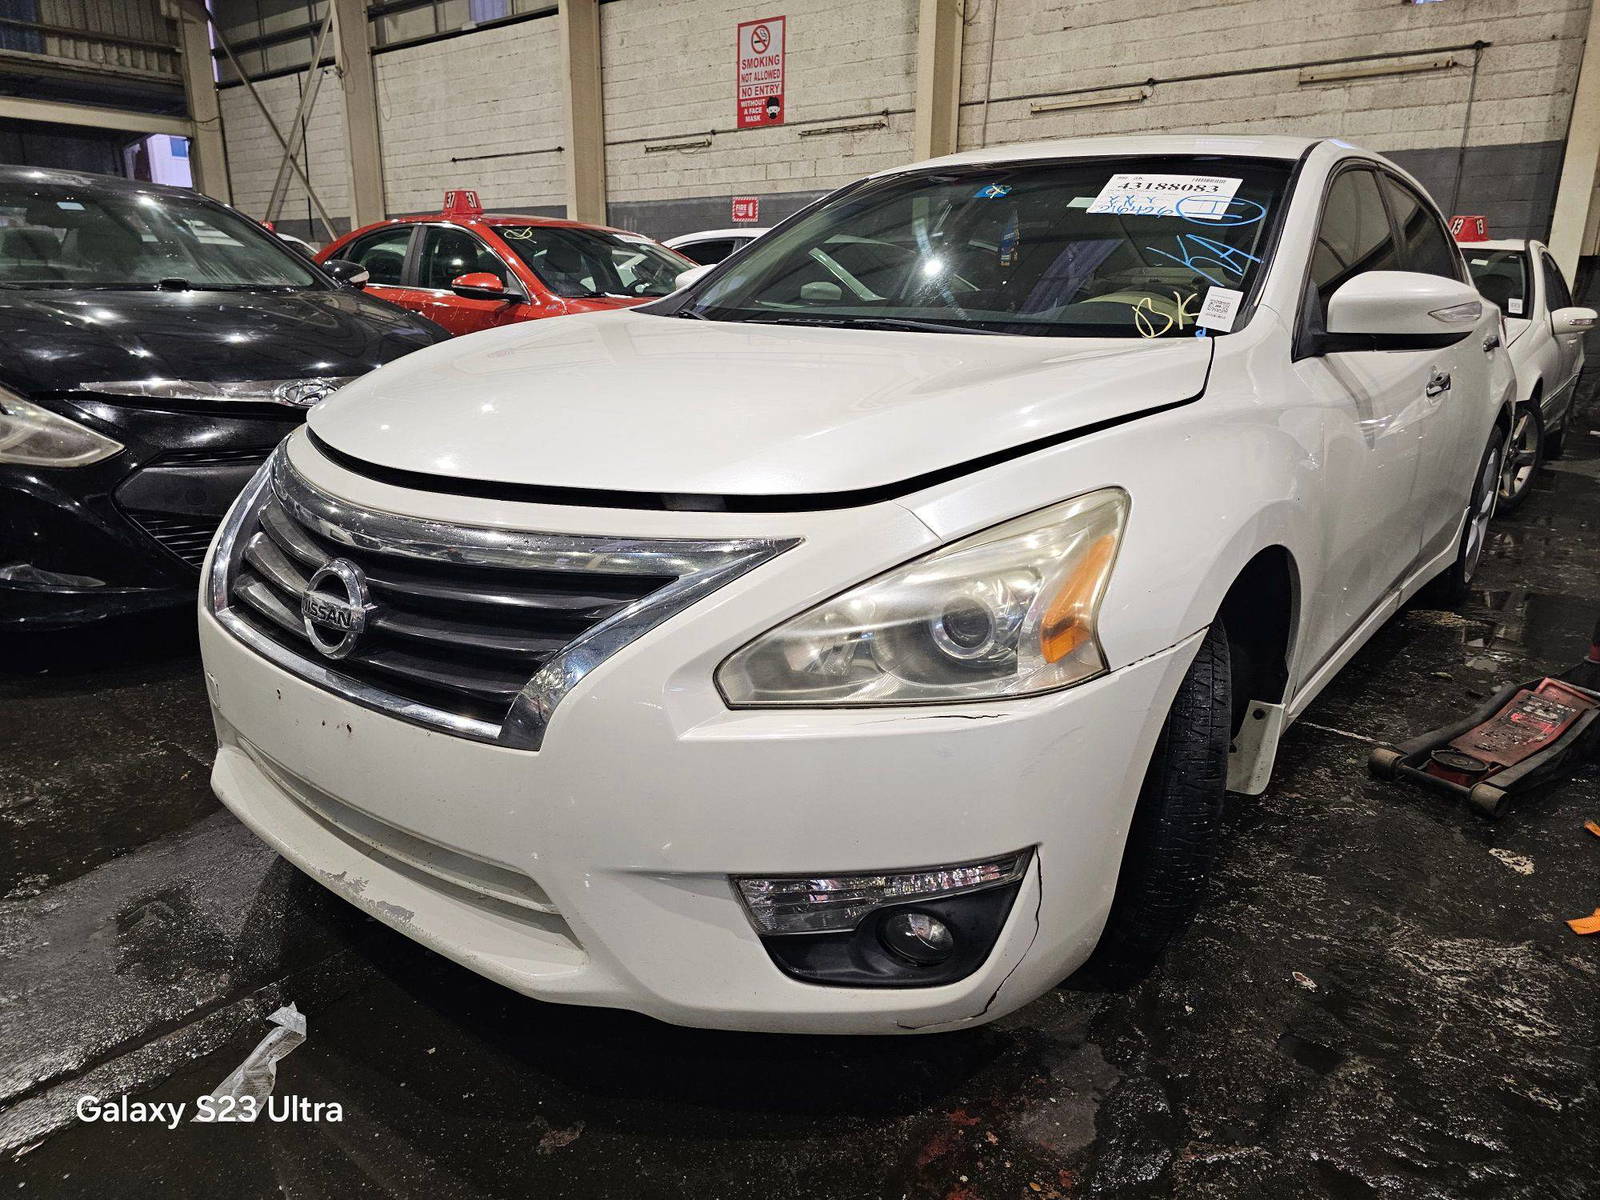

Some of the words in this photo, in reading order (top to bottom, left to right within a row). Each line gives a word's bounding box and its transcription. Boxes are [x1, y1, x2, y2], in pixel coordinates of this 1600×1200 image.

[741, 55, 780, 70] SMOKING
[741, 72, 752, 83] NOT
[754, 69, 780, 81] ALLOWED
[741, 87, 752, 98] NO
[754, 84, 780, 96] ENTRY
[740, 99, 766, 108] WITHOUT
[1117, 182, 1219, 193] 43188083
